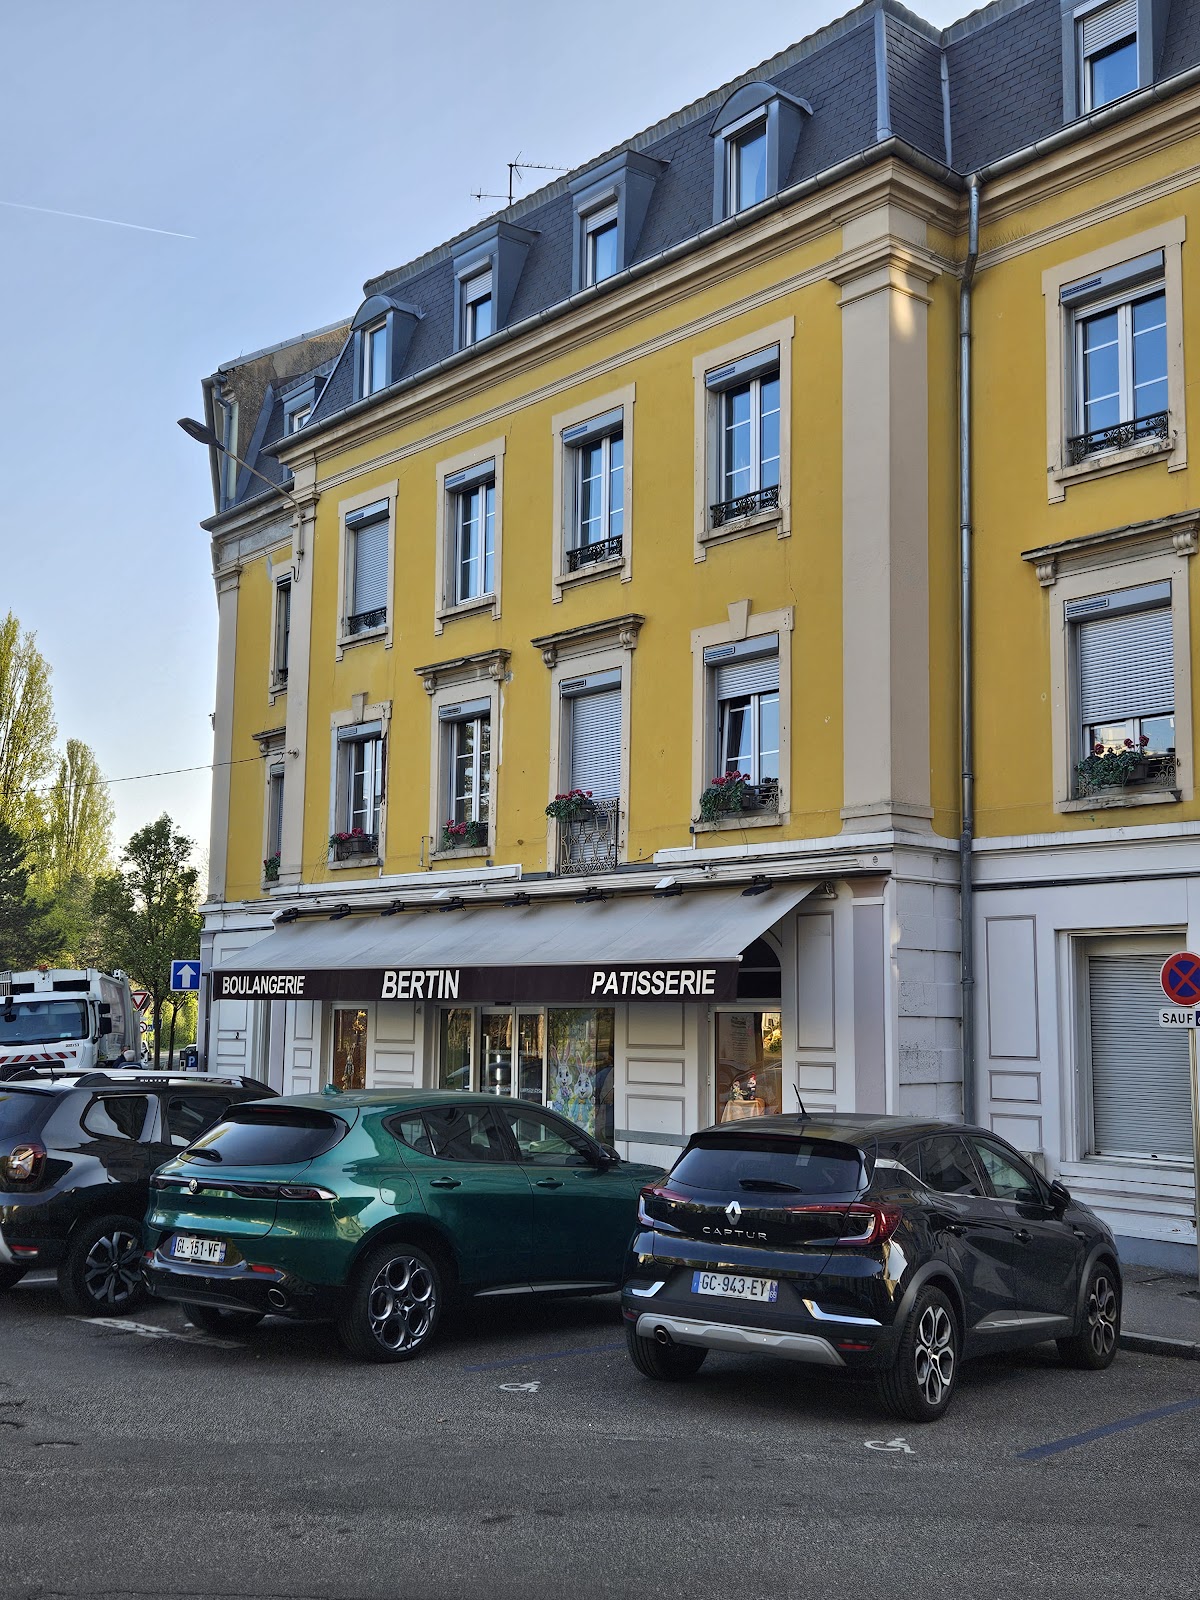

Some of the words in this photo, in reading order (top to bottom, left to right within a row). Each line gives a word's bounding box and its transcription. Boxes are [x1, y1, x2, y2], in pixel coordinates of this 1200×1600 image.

[222, 975, 305, 994] BOULANGERIE
[381, 970, 460, 999] BERTIN
[591, 970, 716, 995] PATISSERIE
[1162, 1013, 1193, 1024] SAUF
[702, 1226, 767, 1240] CAPTUR
[701, 1274, 767, 1297] GC-943-EY
